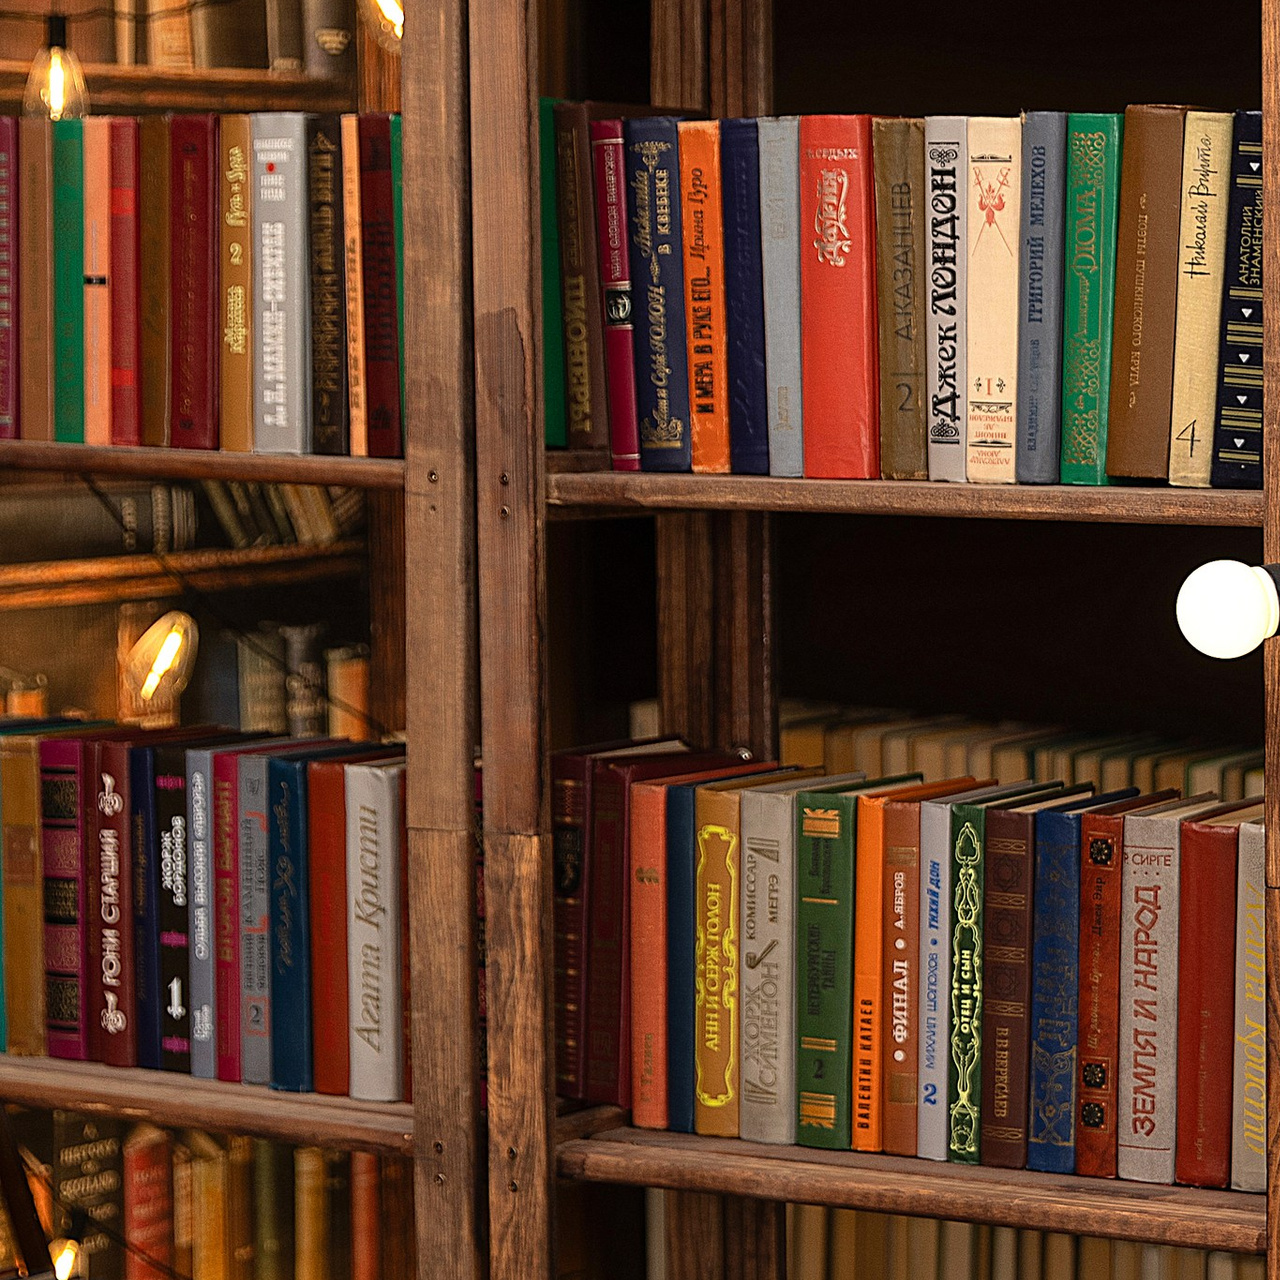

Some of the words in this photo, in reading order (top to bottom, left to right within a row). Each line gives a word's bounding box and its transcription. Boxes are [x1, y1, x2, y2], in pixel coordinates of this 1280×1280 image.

[687, 167, 709, 205] Гуро
[1029, 145, 1047, 226] МЕЛЕХОВ
[1186, 133, 1218, 199] Вирта
[631, 169, 654, 259] Анжелика
[655, 168, 672, 236] КВЕБЕКЕ
[229, 242, 244, 266] 2
[657, 243, 673, 256] В
[688, 210, 710, 262] Ирина
[931, 164, 961, 316] ЛОНДОН
[1070, 187, 1099, 275] ДЮМА
[1137, 213, 1148, 255] ПОЭТЫ
[1183, 200, 1211, 280] Николай
[1237, 205, 1254, 285] АНАТОЛИЙ
[1248, 188, 1263, 286] ЗНАМЕНСКИЙ
[893, 180, 914, 342] А.КАЗАНЦЕВ
[1026, 236, 1046, 325] ГРИГОРИЙ
[647, 283, 668, 353] ГОЛОН
[691, 305, 713, 341] РУКЕ
[1131, 258, 1146, 347] ПУШКИНСКОГО
[565, 274, 592, 434] ПИОНЕРЫ
[693, 345, 713, 355] В
[931, 321, 961, 423] Джек
[1128, 351, 1141, 387] КРУГА
[693, 360, 715, 400] МЕРА
[897, 382, 913, 413] 2
[696, 403, 714, 414] И
[968, 413, 1013, 424] БРАЖЕЛОН
[974, 430, 1007, 440] ВИКОНТ
[984, 422, 995, 431] ДЕ
[1026, 395, 1040, 452] ВЛАДИМИР
[969, 455, 1011, 465] АЛЕКСАНДР
[977, 449, 1001, 457] ДЮМА
[1175, 419, 1202, 459] 4
[100, 827, 121, 924] СТАРШИЙ
[160, 830, 173, 890] ЖОРЖ
[193, 840, 207, 906] ВЫСОКАЯ
[253, 847, 265, 894] ПОЯС
[354, 805, 386, 932] Кристи
[928, 859, 941, 889] ДОН
[1132, 852, 1172, 867] СИРГЕ
[704, 882, 722, 941] ГОЛОН
[746, 854, 757, 941] КОМИССАР
[767, 874, 779, 924] МЕГРЭ
[893, 870, 906, 930] А.ЯБРОВ
[926, 888, 941, 931] ТИХИЙ
[102, 925, 122, 987] РОНИ
[194, 907, 209, 960] СУДЬБА
[1133, 884, 1161, 991] НАРОД
[1245, 881, 1266, 1002] Агата
[704, 944, 720, 992] СЕРЖ
[925, 952, 939, 1013] ШОЛОХОВ
[960, 949, 972, 980] СЫН
[961, 983, 971, 995] И
[166, 975, 185, 1019] 1
[249, 1003, 262, 1024] 2
[354, 943, 382, 1055] Агата
[704, 994, 720, 1010] И
[744, 983, 761, 1066] ЖОРЖ
[758, 960, 779, 1088] СИМЕНОН
[892, 959, 909, 1044] ФИНАЛ
[960, 999, 972, 1034] ОТЕЦ
[1133, 997, 1158, 1022] И
[704, 1012, 720, 1052] АНН
[859, 998, 874, 1052] КАТАЕВ
[925, 1016, 937, 1069] МИХАИЛ
[857, 1058, 872, 1130] ВАЛЕНТИН
[922, 1083, 938, 1106] 2
[994, 1049, 1009, 1118] ВЕРЕСАЕВ
[1132, 1028, 1158, 1138] ЗЕМЛЯ
[1236, 1013, 1267, 1156] Кристи
